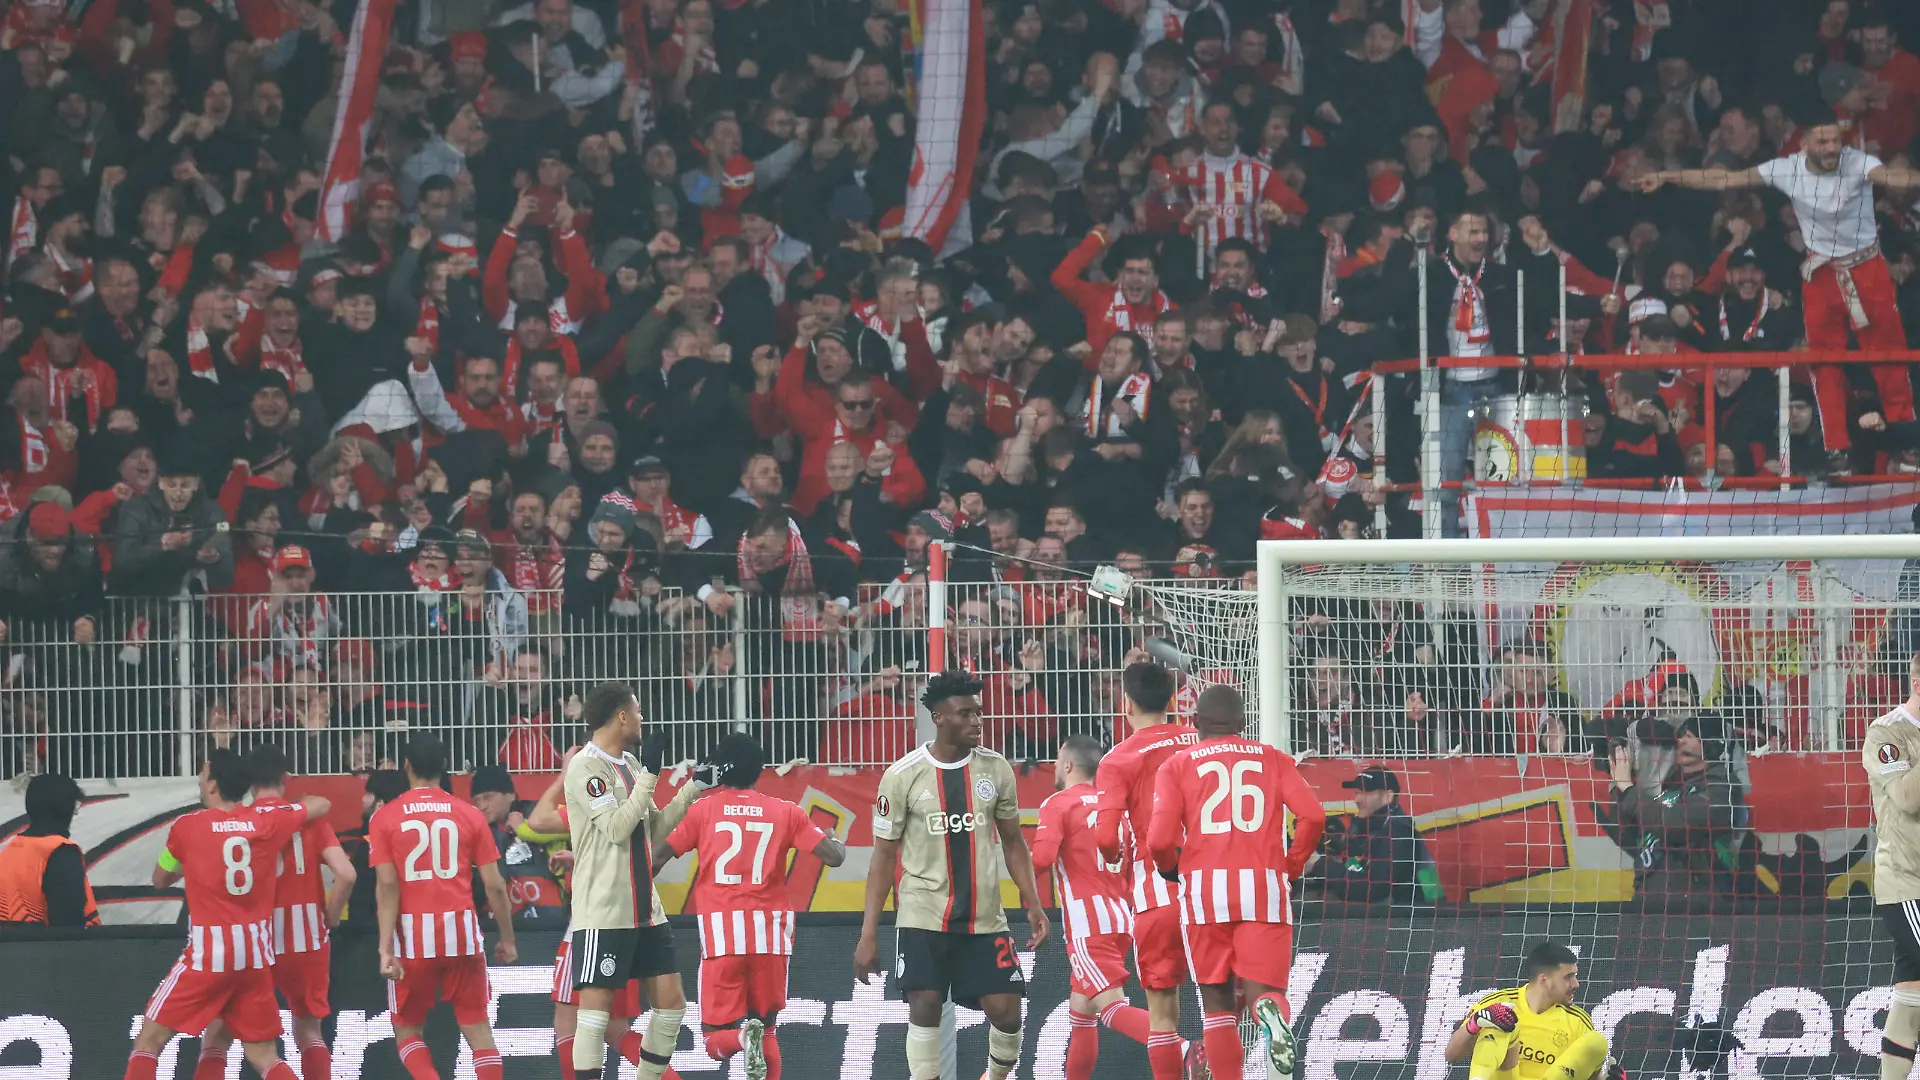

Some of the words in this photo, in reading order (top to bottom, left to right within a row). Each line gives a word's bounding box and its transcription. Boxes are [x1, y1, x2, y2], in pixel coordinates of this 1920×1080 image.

[1174, 732, 1199, 746] LEIT
[1190, 743, 1264, 760] ROUSSILLON
[402, 802, 452, 815] LAIDOUNI
[723, 804, 763, 817] BECKER
[1196, 759, 1265, 835] 26
[222, 835, 254, 896] 8
[400, 818, 459, 882] 20
[714, 820, 774, 885] 27
[1196, 944, 1920, 1080] Vehcles
